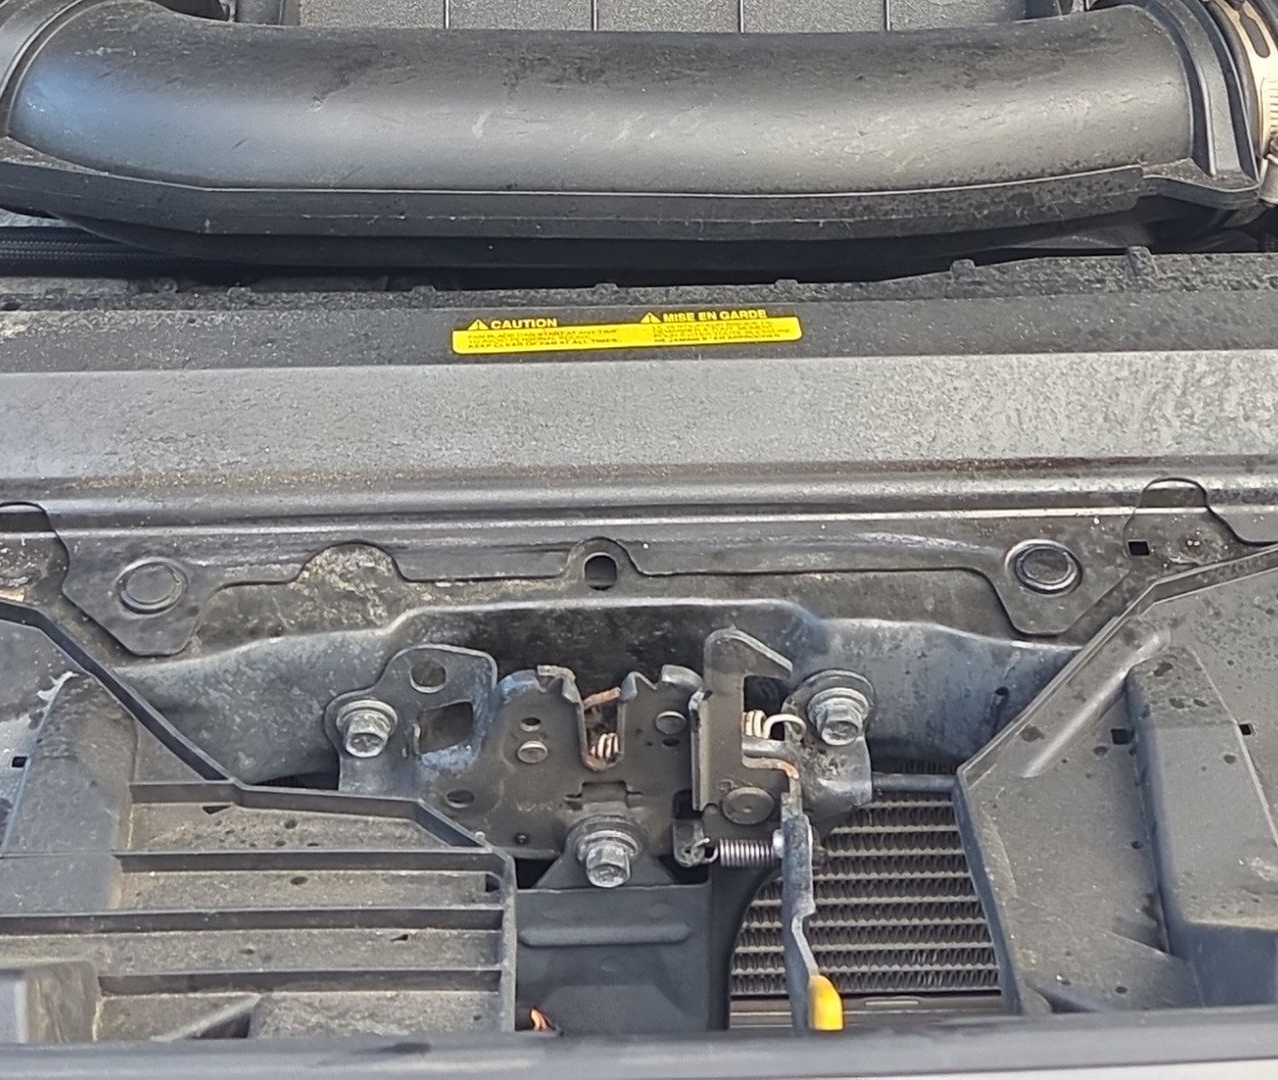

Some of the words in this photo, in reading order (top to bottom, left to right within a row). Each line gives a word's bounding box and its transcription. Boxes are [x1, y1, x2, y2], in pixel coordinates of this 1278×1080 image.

[663, 312, 695, 323] MISE
[698, 311, 717, 322] EN
[719, 309, 767, 320] GARDE
[490, 318, 557, 329] CAUTION
